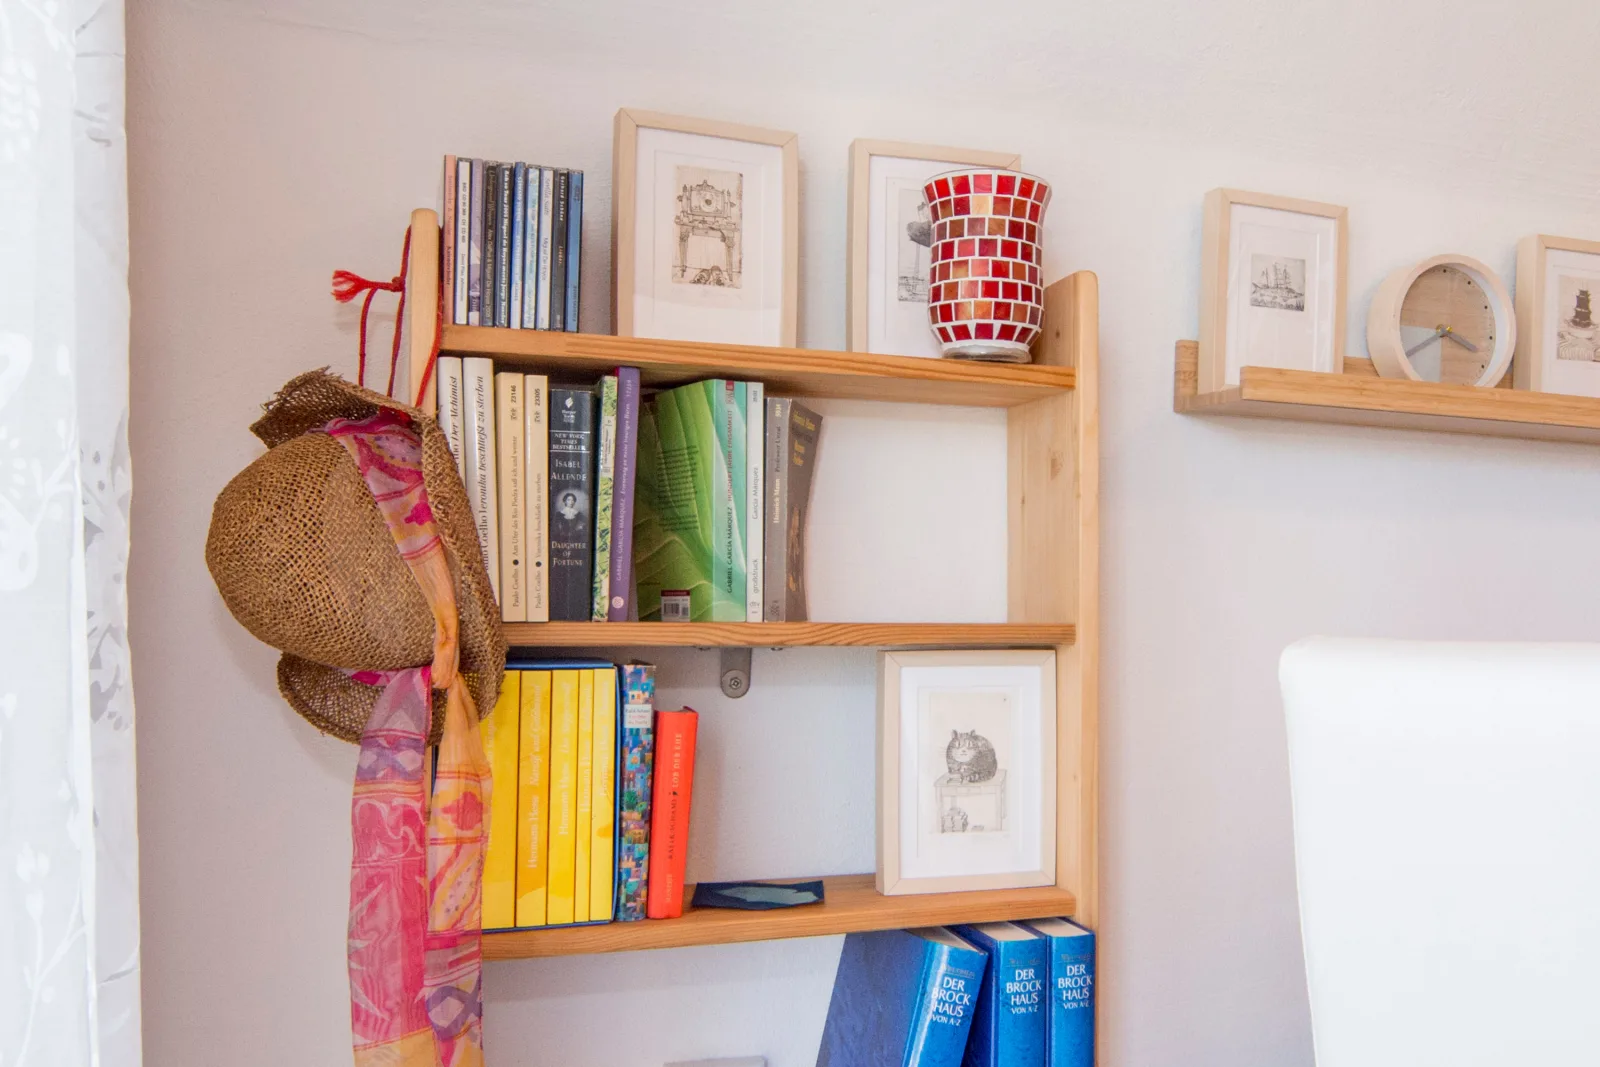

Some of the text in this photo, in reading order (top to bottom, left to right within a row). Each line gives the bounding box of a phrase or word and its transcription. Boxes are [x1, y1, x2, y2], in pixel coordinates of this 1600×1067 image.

[449, 376, 458, 418] Alchimist
[475, 376, 486, 410] sterben
[478, 410, 486, 424] zu
[450, 424, 458, 441] Der
[477, 426, 488, 471] beschließt
[556, 460, 581, 468] ISABEL
[551, 472, 587, 481] ALLENDE
[772, 498, 780, 523] Heinrich
[552, 541, 586, 550] DAUGHTER
[552, 558, 584, 567] FORTUNE
[616, 556, 624, 581] GABRIEL
[726, 567, 734, 594] GABRIEL
[558, 792, 568, 834] Hermann
[528, 824, 538, 868] Hermann
[1015, 968, 1036, 981] DER
[1066, 964, 1086, 976] DER
[943, 976, 966, 992] DER
[1006, 980, 1042, 994] BROCK
[1058, 975, 1092, 989] BROCK
[931, 988, 972, 1006] BROCK
[1011, 992, 1038, 1006] HAUS
[1062, 988, 1090, 1001] HAUS
[934, 1002, 964, 1018] HAUS
[1012, 1006, 1027, 1014] VON
[1064, 1002, 1078, 1010] VON
[932, 1014, 948, 1024] VON
